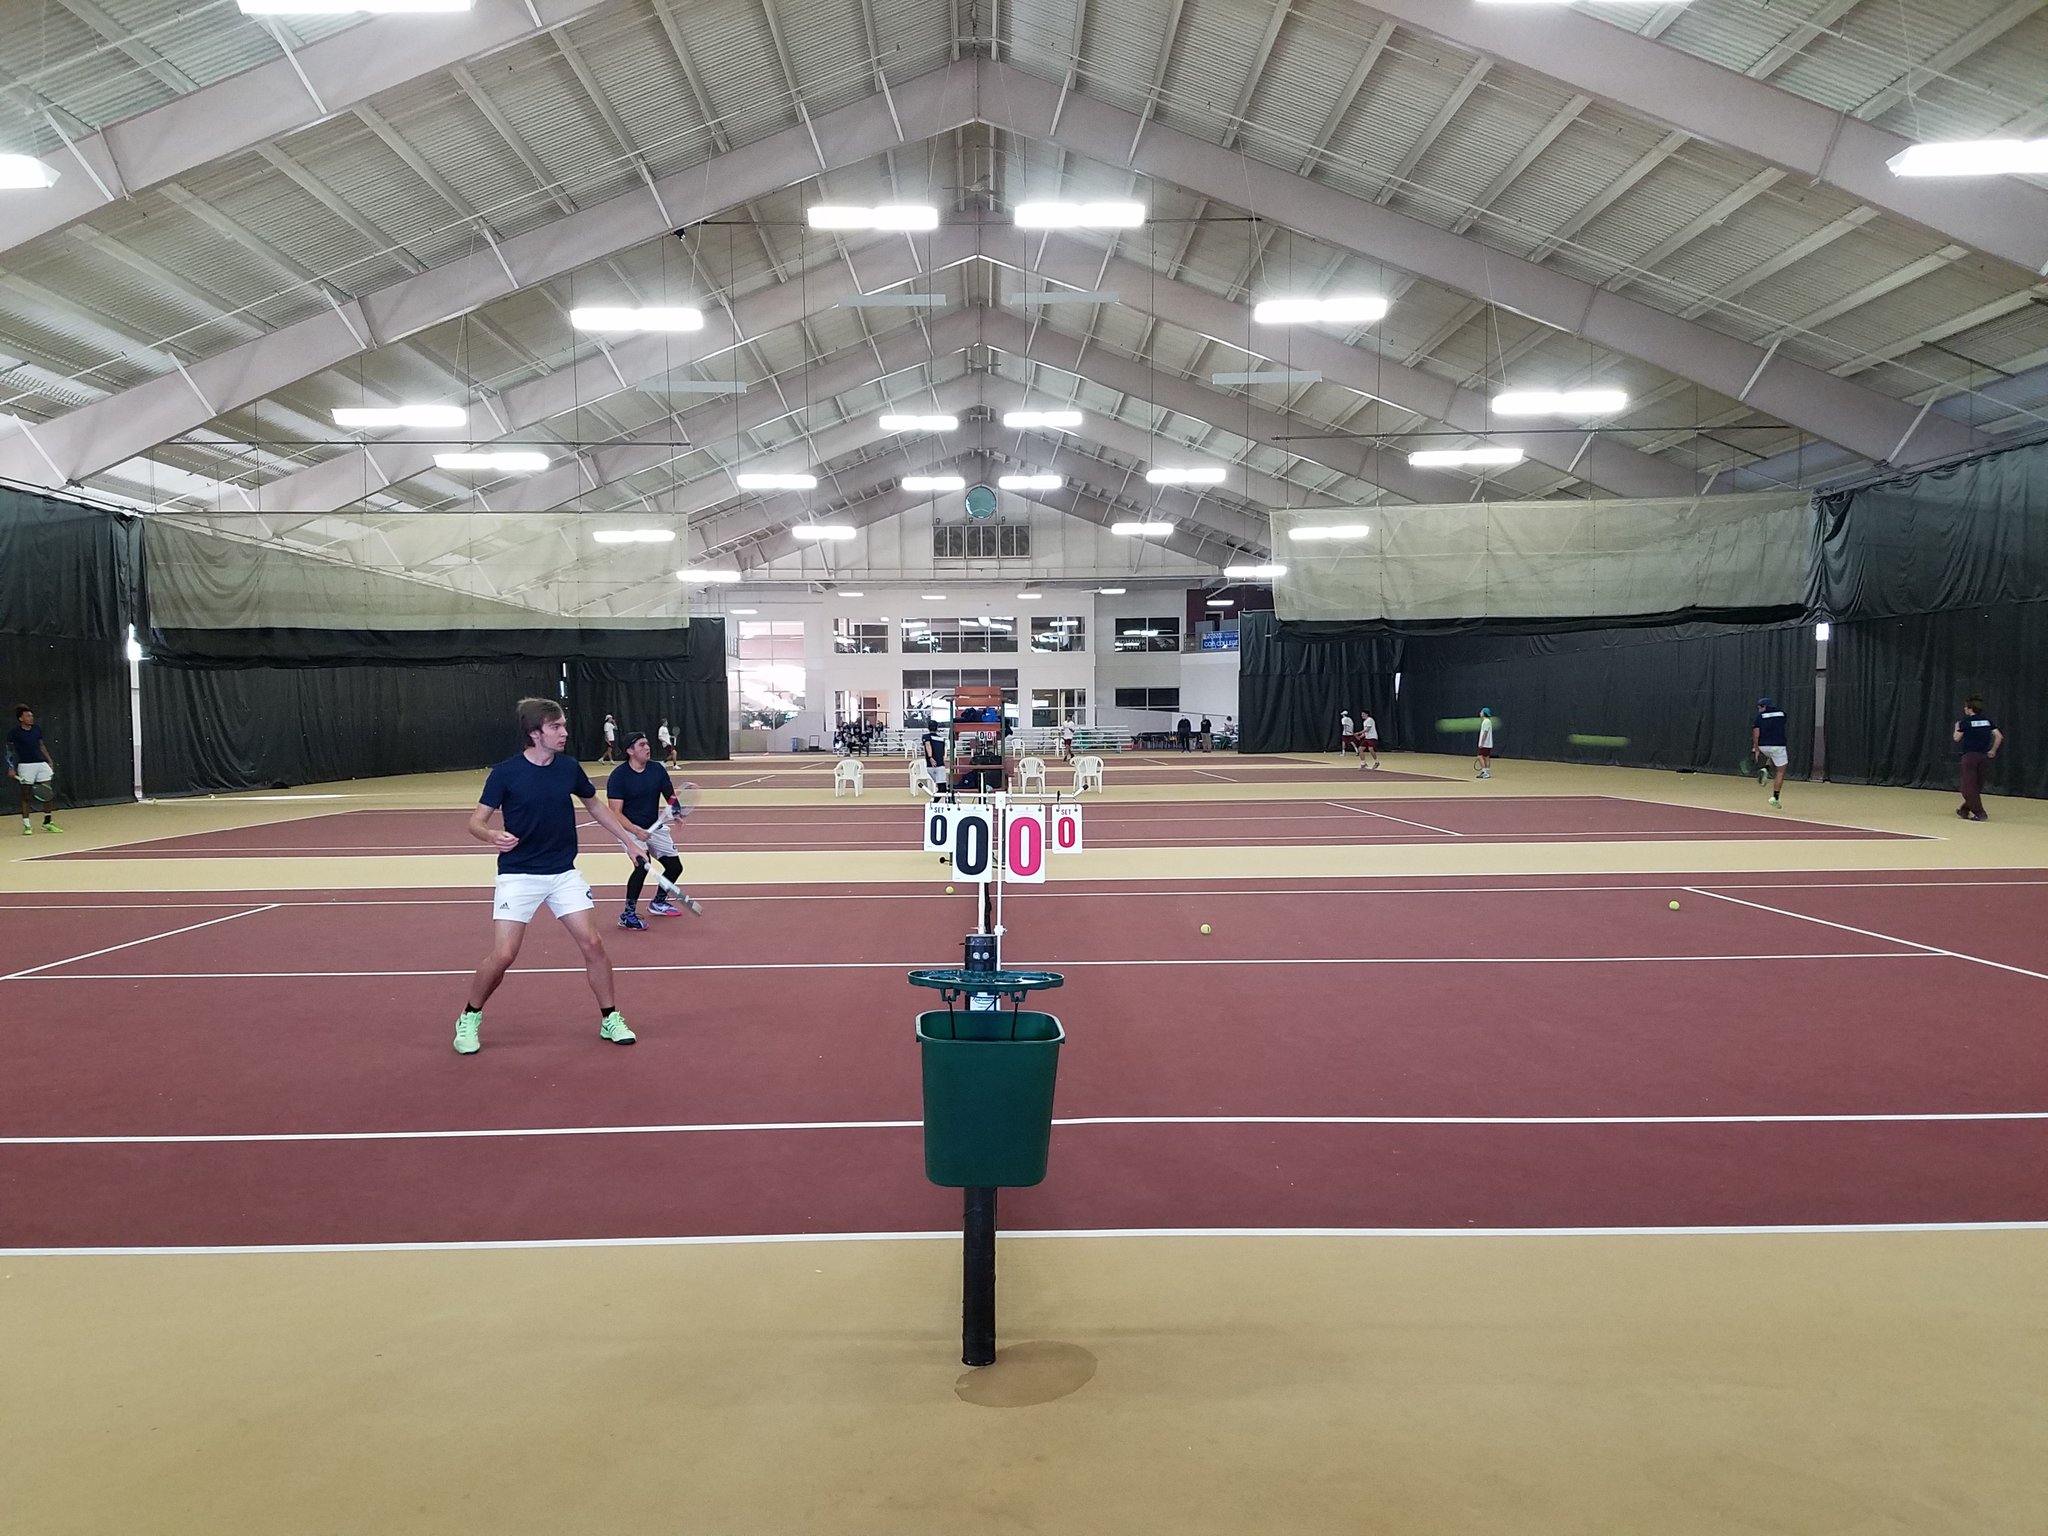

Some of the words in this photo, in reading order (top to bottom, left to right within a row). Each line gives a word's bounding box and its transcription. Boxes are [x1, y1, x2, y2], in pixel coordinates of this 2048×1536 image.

[930, 815, 947, 845] 0
[956, 816, 989, 876] 0
[1009, 817, 1041, 876] 0
[1058, 817, 1075, 848] 0
